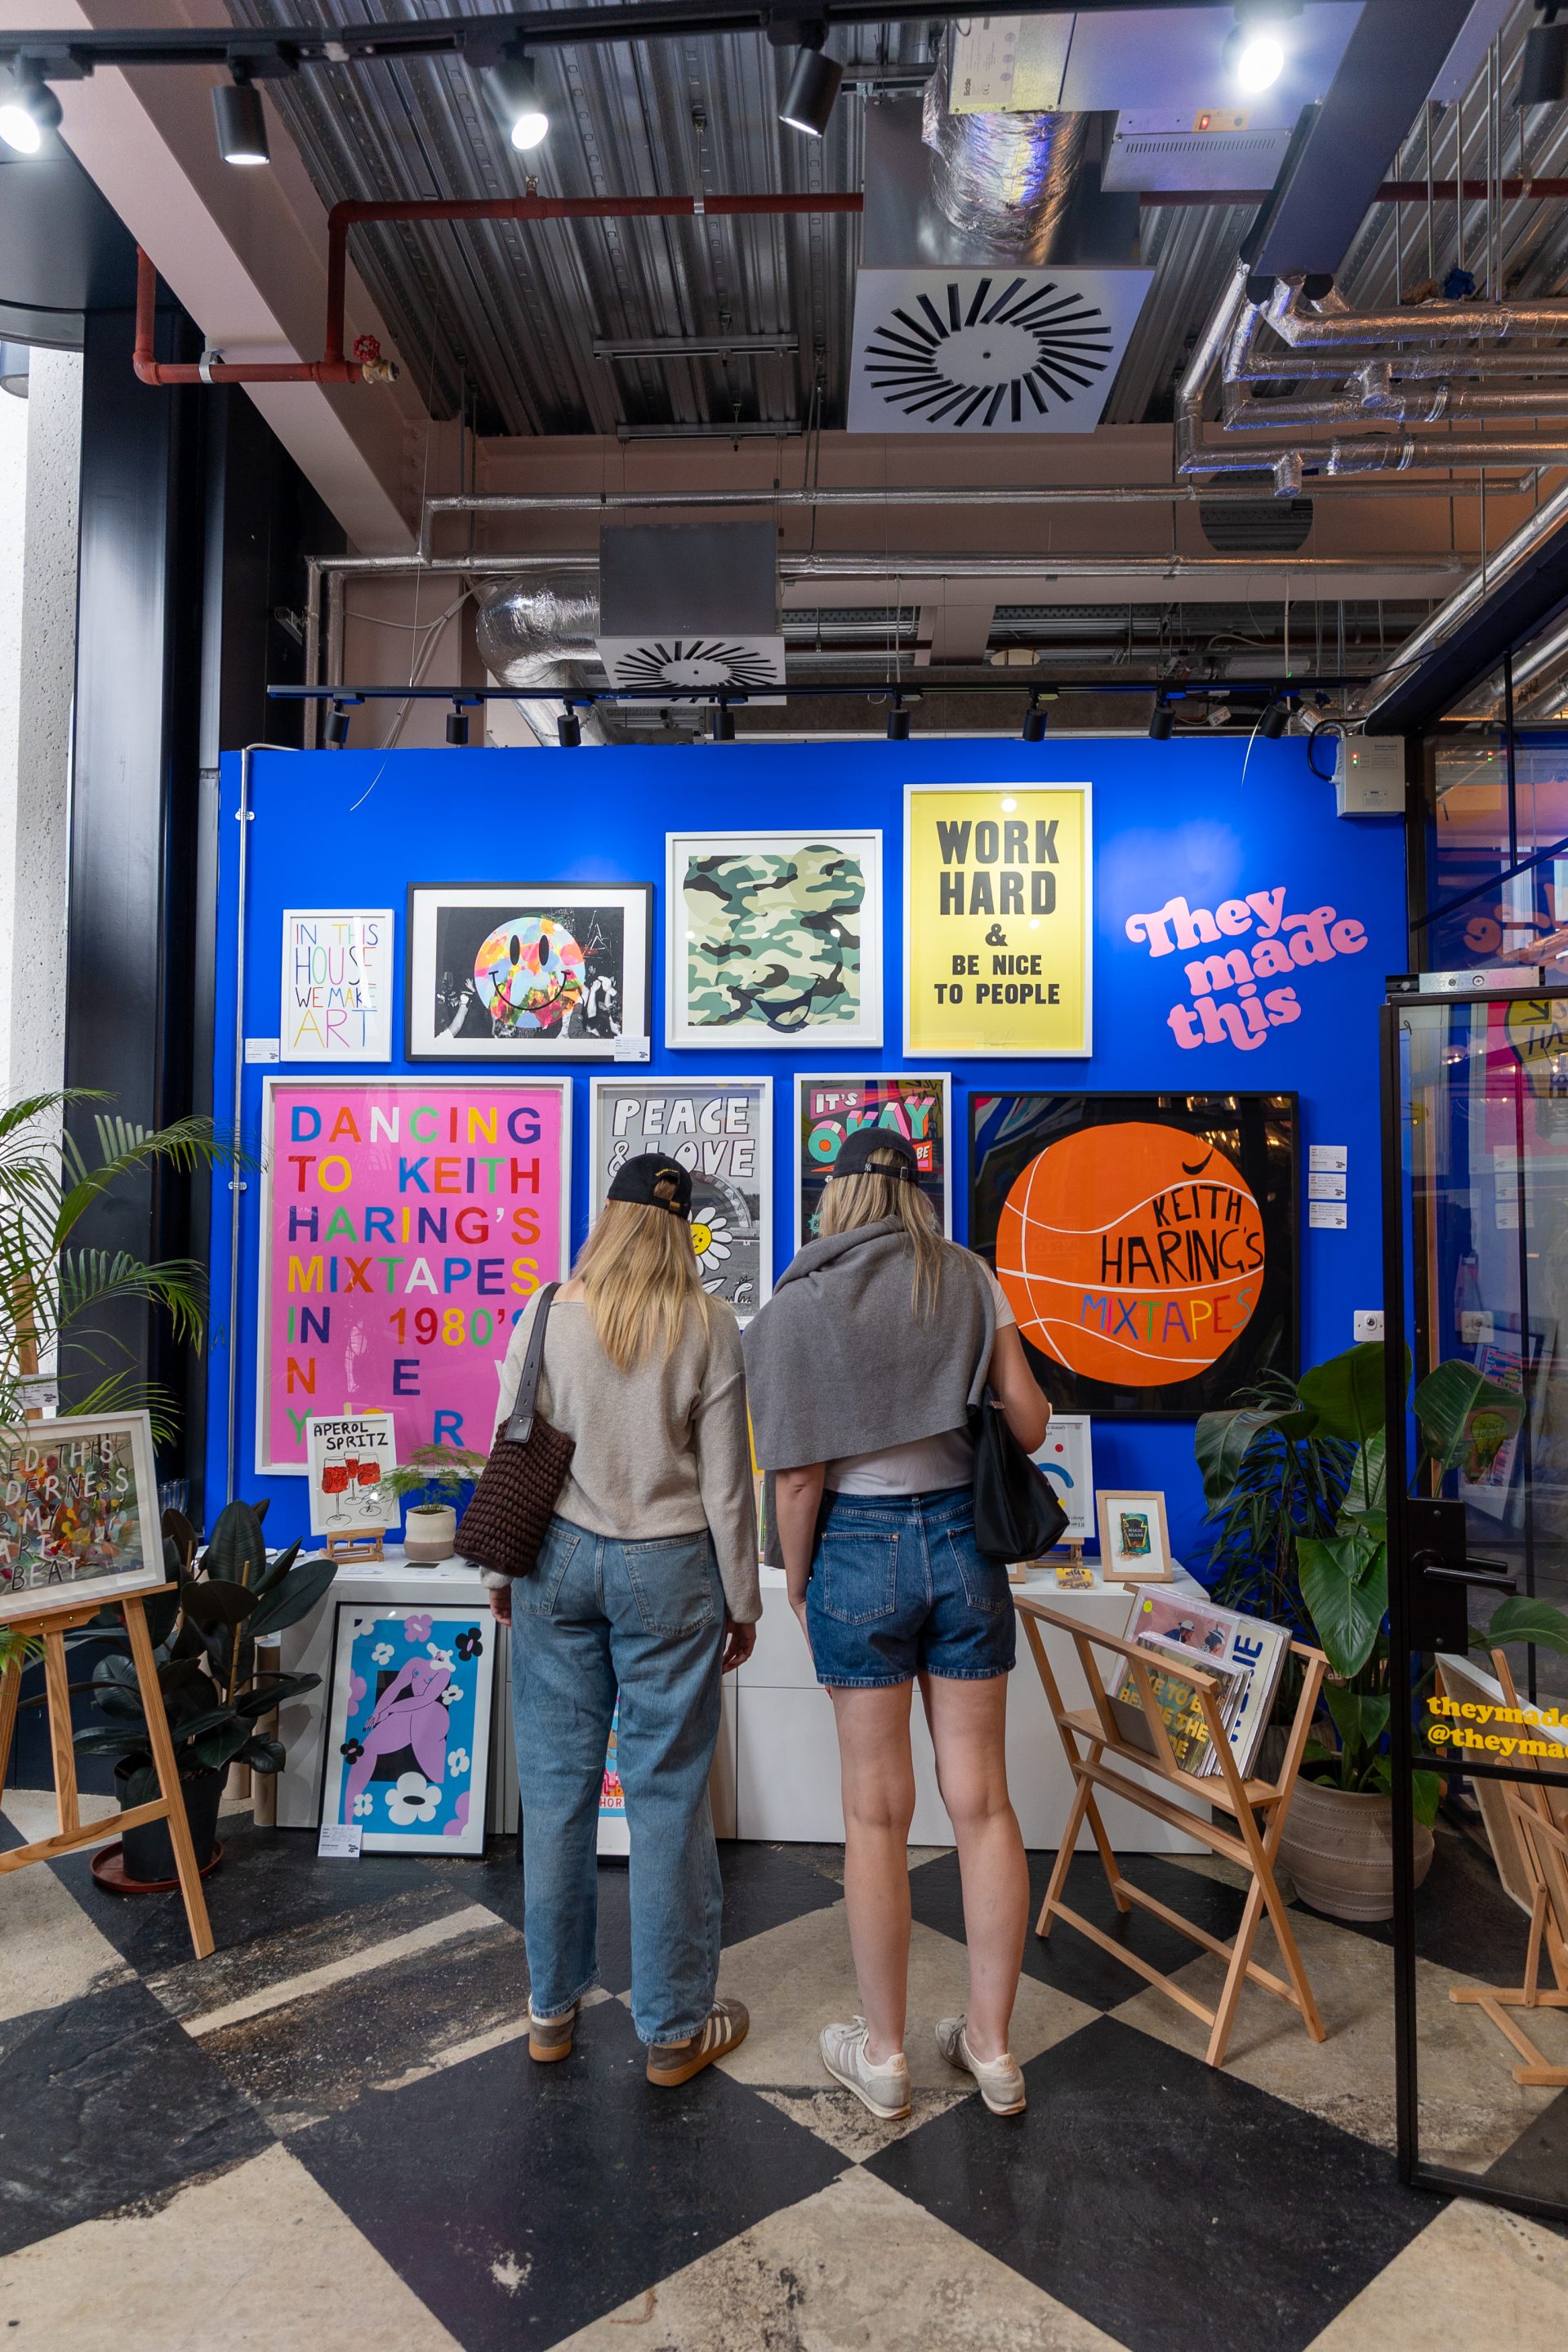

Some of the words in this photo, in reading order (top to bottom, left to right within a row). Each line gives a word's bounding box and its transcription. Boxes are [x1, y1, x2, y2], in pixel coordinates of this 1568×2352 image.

[936, 819, 1060, 864] WORK
[939, 871, 1056, 915] HARD
[295, 923, 317, 946] IN
[331, 923, 379, 946] THIS
[984, 923, 1009, 947] &
[1124, 886, 1287, 958] They
[295, 946, 377, 987] HOUSE
[951, 955, 979, 976] BE
[992, 955, 1042, 976] NICE
[1183, 905, 1369, 997] made
[295, 987, 320, 1009] WE
[327, 987, 377, 1009] MAKE
[934, 983, 964, 1004] TO
[976, 983, 1061, 1004] PEOPLE
[293, 1009, 378, 1049] ART
[1166, 982, 1302, 1051] this
[612, 1096, 751, 1137] PEACE
[816, 1092, 858, 1114] IT'S
[290, 1105, 542, 1144] DANCING
[607, 1140, 632, 1178] &
[915, 1145, 931, 1160] BE
[288, 1156, 352, 1193] TO
[399, 1156, 541, 1194] KEITH
[1152, 1184, 1242, 1227] KEITH
[288, 1205, 541, 1245] HARING'S
[1100, 1226, 1265, 1285] HARING'S
[287, 1255, 541, 1296] MIXTAPES
[287, 1306, 331, 1345] IN
[1080, 1286, 1254, 1343] MIXTAPES
[314, 1422, 369, 1437] APEROL
[326, 1432, 389, 1450] SPRITZ
[56, 1439, 115, 1469] THIS
[22, 1503, 62, 1535] MY
[11, 1556, 81, 1592] BEAT
[1167, 1682, 1189, 1707] TO
[1176, 1712, 1210, 1744] THE
[1428, 1724, 1568, 1759] @theyma
